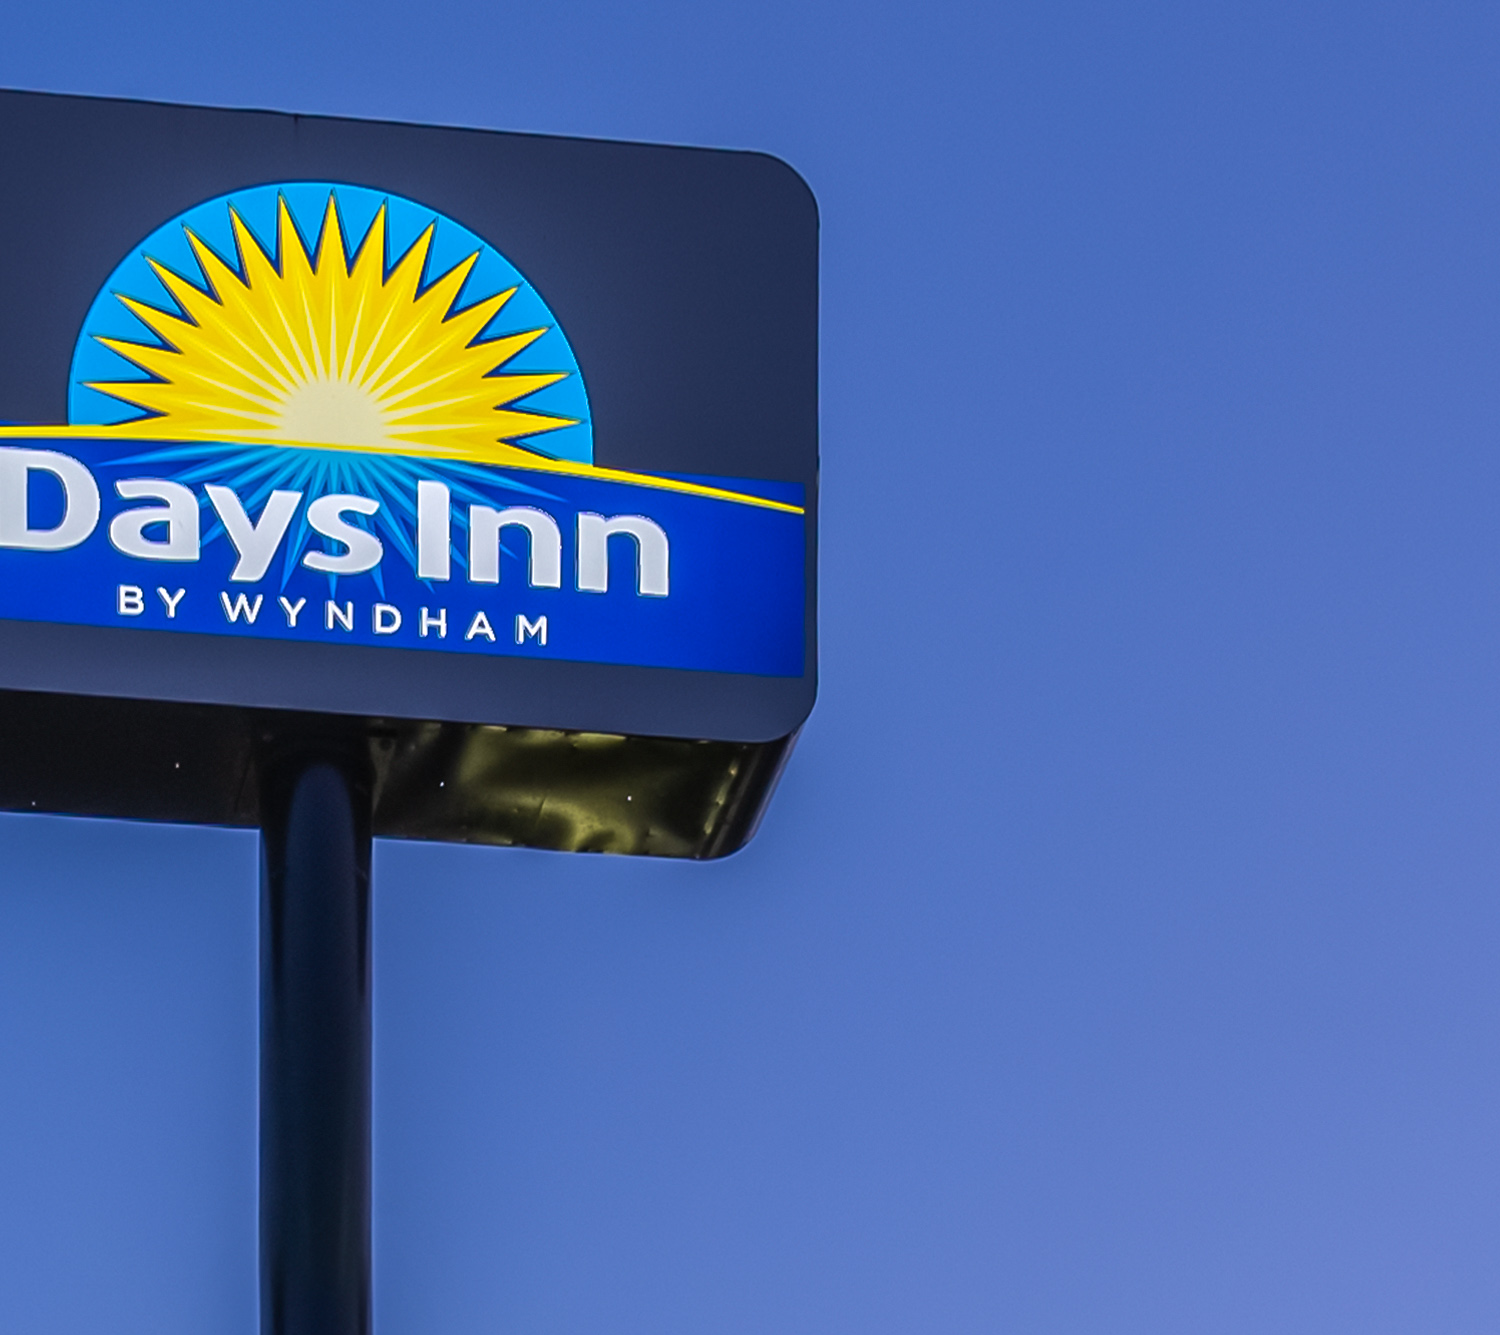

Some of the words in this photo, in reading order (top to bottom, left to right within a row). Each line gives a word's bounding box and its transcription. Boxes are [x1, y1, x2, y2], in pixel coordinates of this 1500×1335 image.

[416, 478, 671, 598] Inn
[117, 583, 187, 619] BY
[220, 590, 549, 647] WYNDHAM
